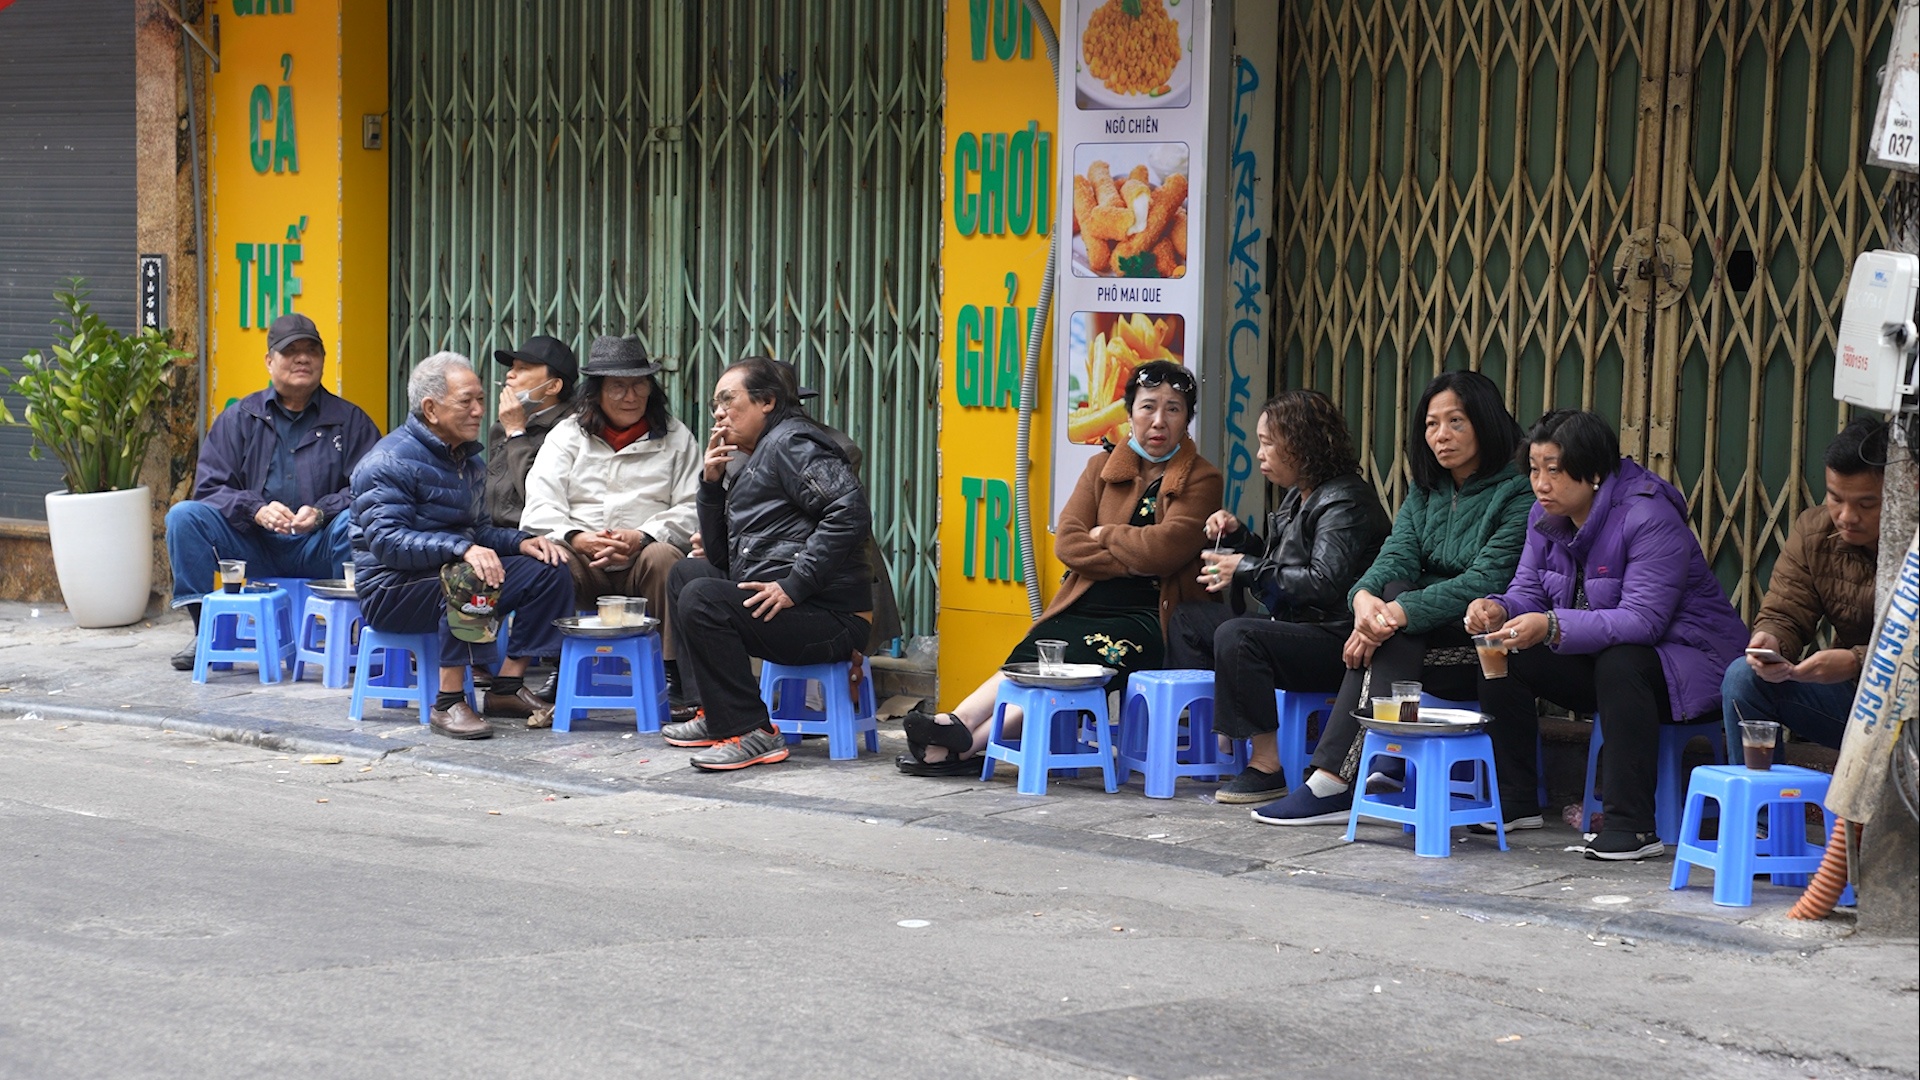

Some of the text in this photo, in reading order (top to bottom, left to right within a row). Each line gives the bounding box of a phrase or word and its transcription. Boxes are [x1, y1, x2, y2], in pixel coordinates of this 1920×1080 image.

[249, 53, 299, 173] CẢ
[1105, 115, 1159, 134] NGÔ CHIÊN
[1888, 133, 1913, 158] 037
[954, 120, 1050, 236] CHƠI
[235, 215, 308, 330] THẾ
[1097, 283, 1162, 303] PHÔ MAI QUE
[956, 271, 1038, 409] GIẢ
[1843, 352, 1868, 371] 19001515
